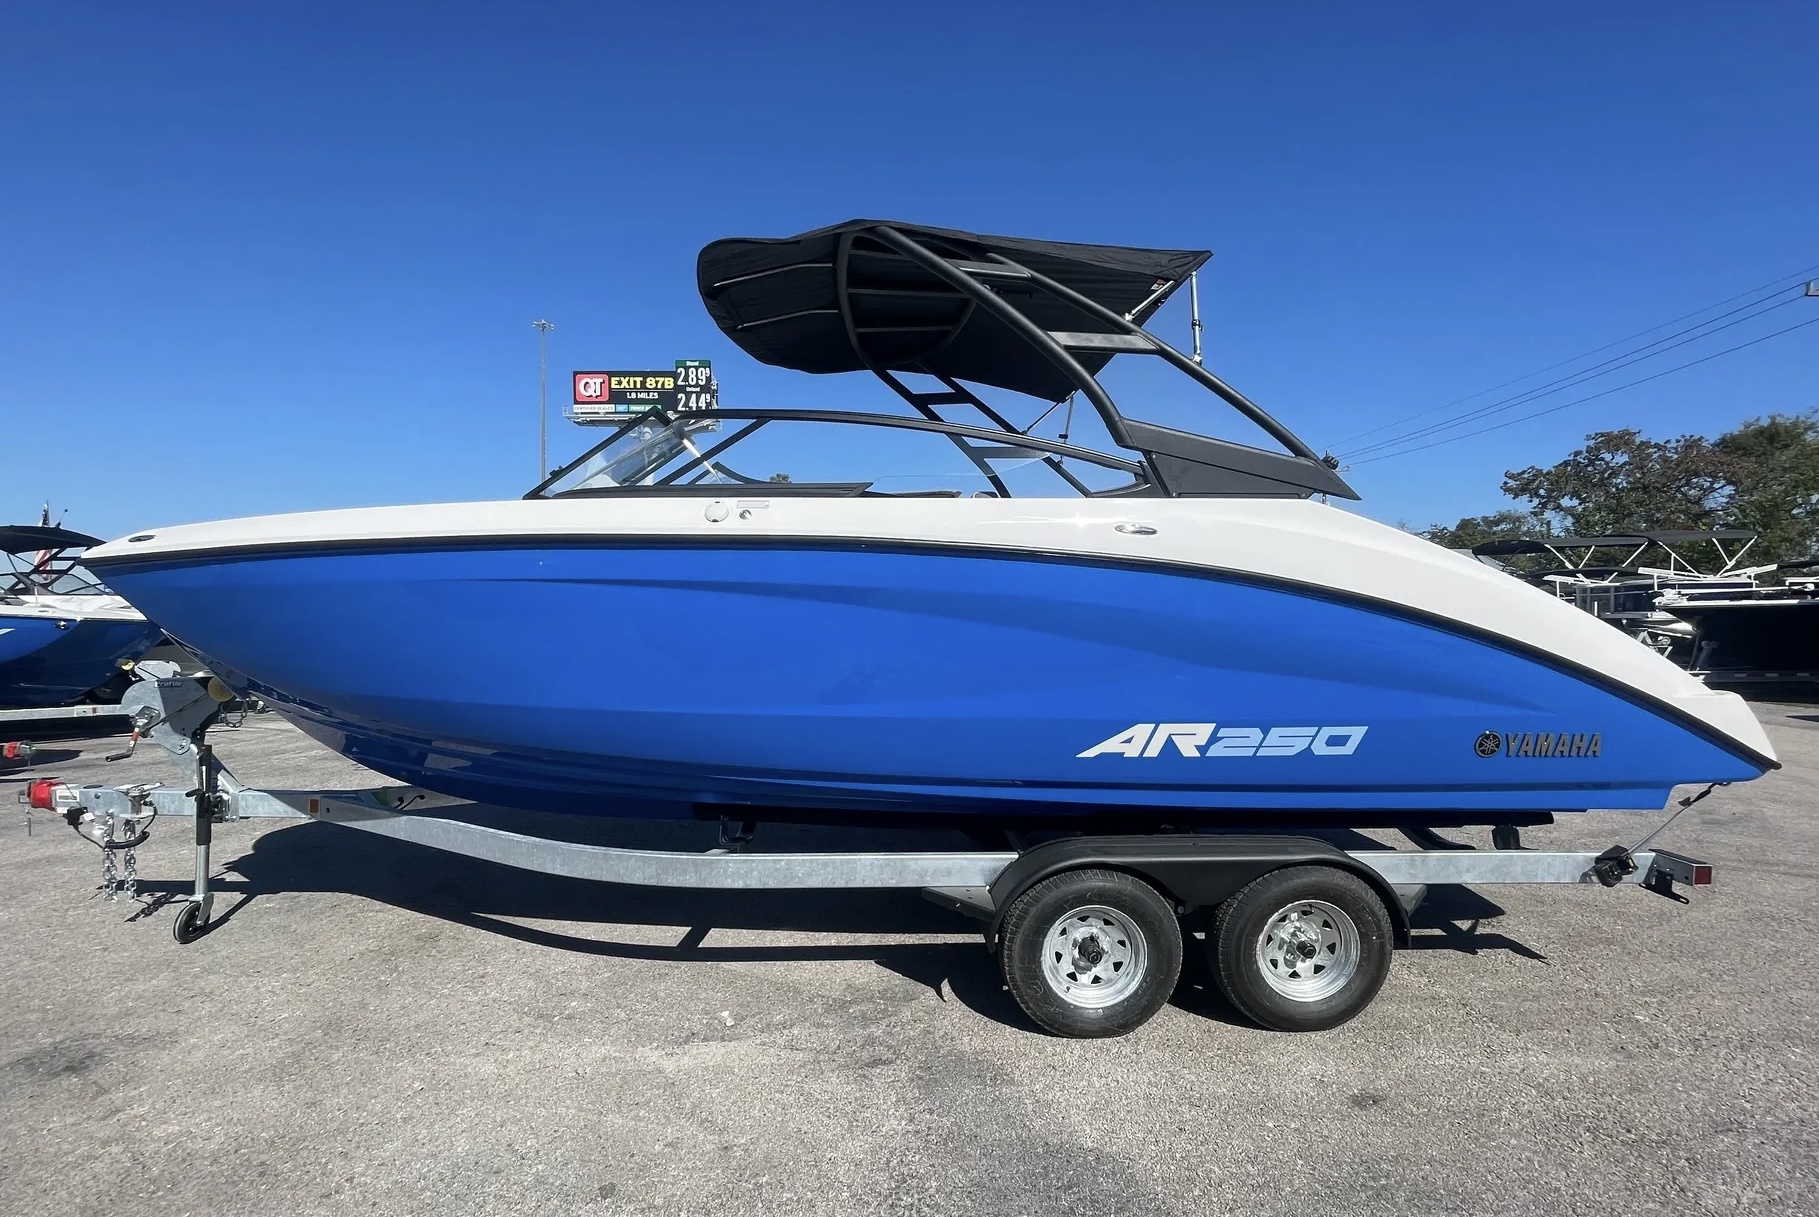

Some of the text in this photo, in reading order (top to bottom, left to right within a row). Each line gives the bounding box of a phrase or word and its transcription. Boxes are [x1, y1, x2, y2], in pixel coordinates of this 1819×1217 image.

[579, 378, 604, 397] QT
[611, 377, 674, 389] EXIT 87B
[1076, 723, 1368, 757] AR250
[1506, 732, 1601, 757] YAMAHA
